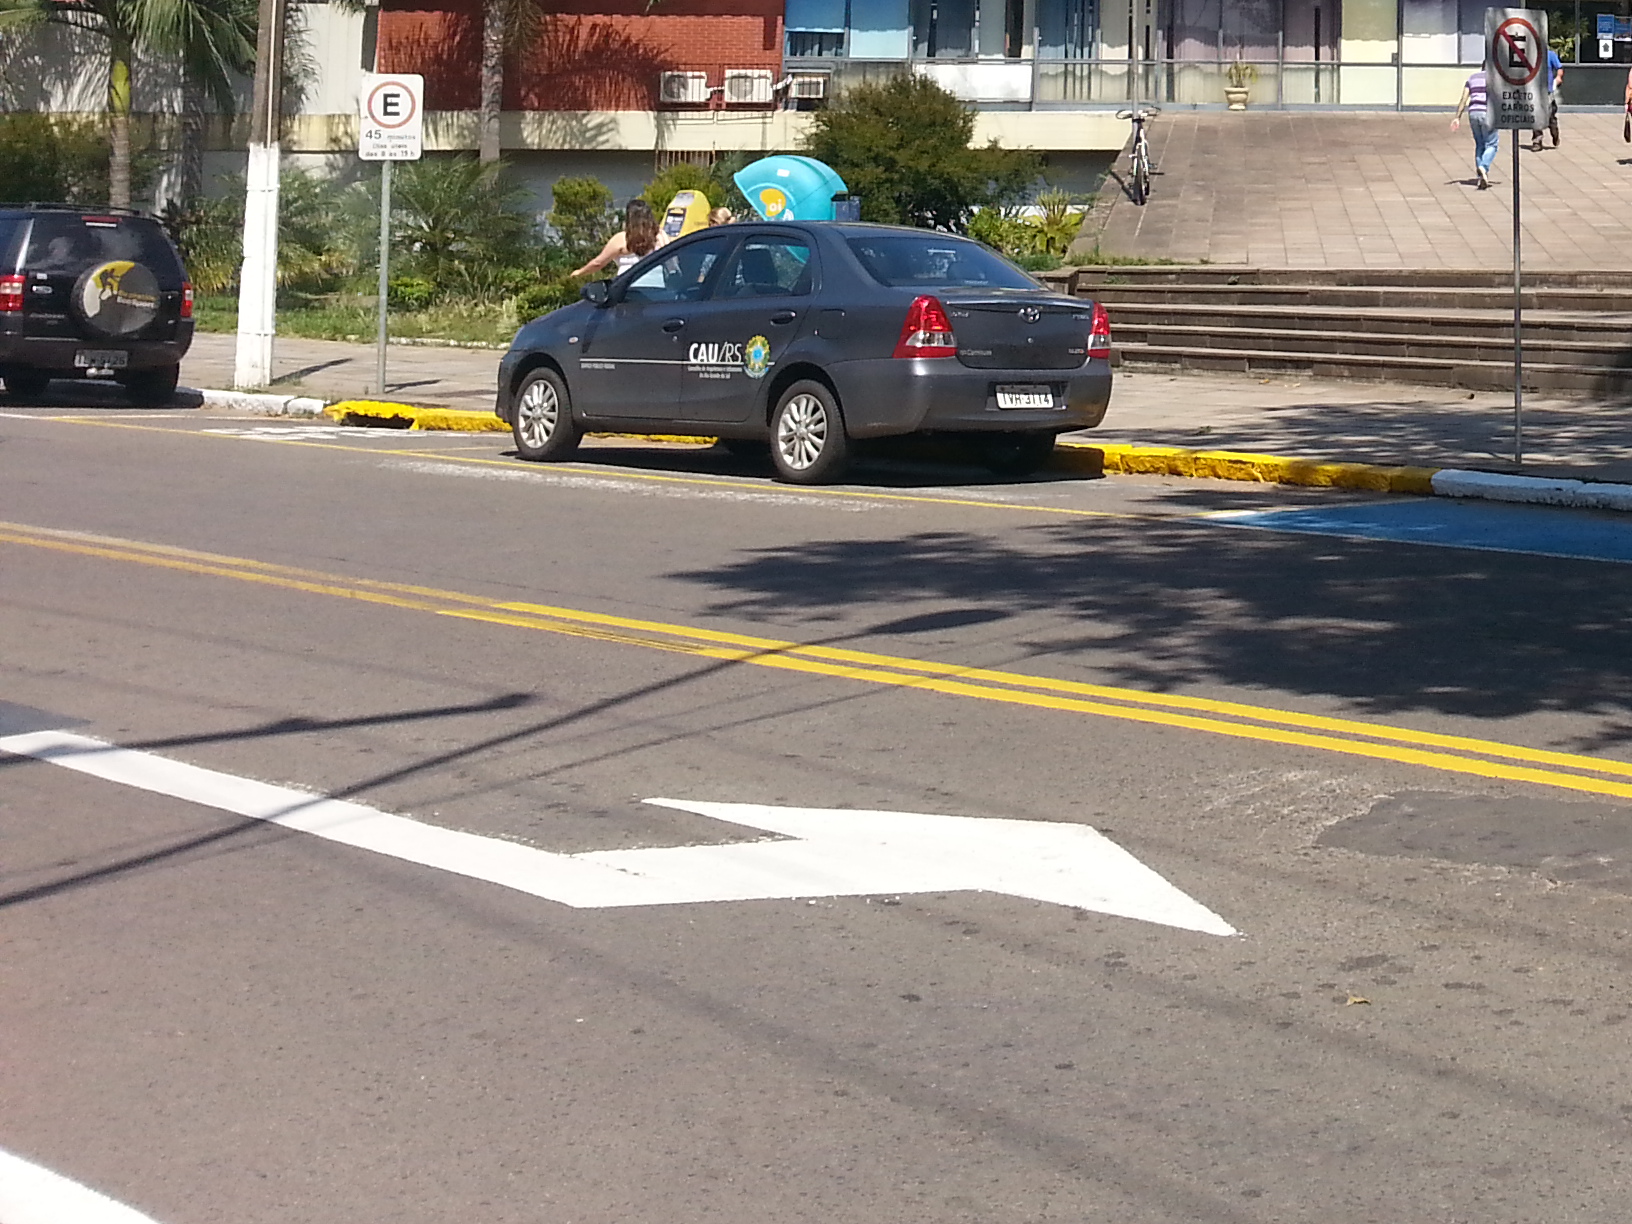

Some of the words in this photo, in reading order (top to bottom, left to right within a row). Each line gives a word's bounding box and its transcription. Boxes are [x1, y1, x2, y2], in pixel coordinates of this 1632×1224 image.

[1508, 34, 1526, 67] E
[1502, 91, 1533, 101] EXCETO
[383, 93, 400, 116] E
[1501, 103, 1534, 112] CARROS
[1501, 114, 1535, 124] OFICIAIS
[365, 129, 382, 140] 45
[689, 341, 742, 363] CAU/RS
